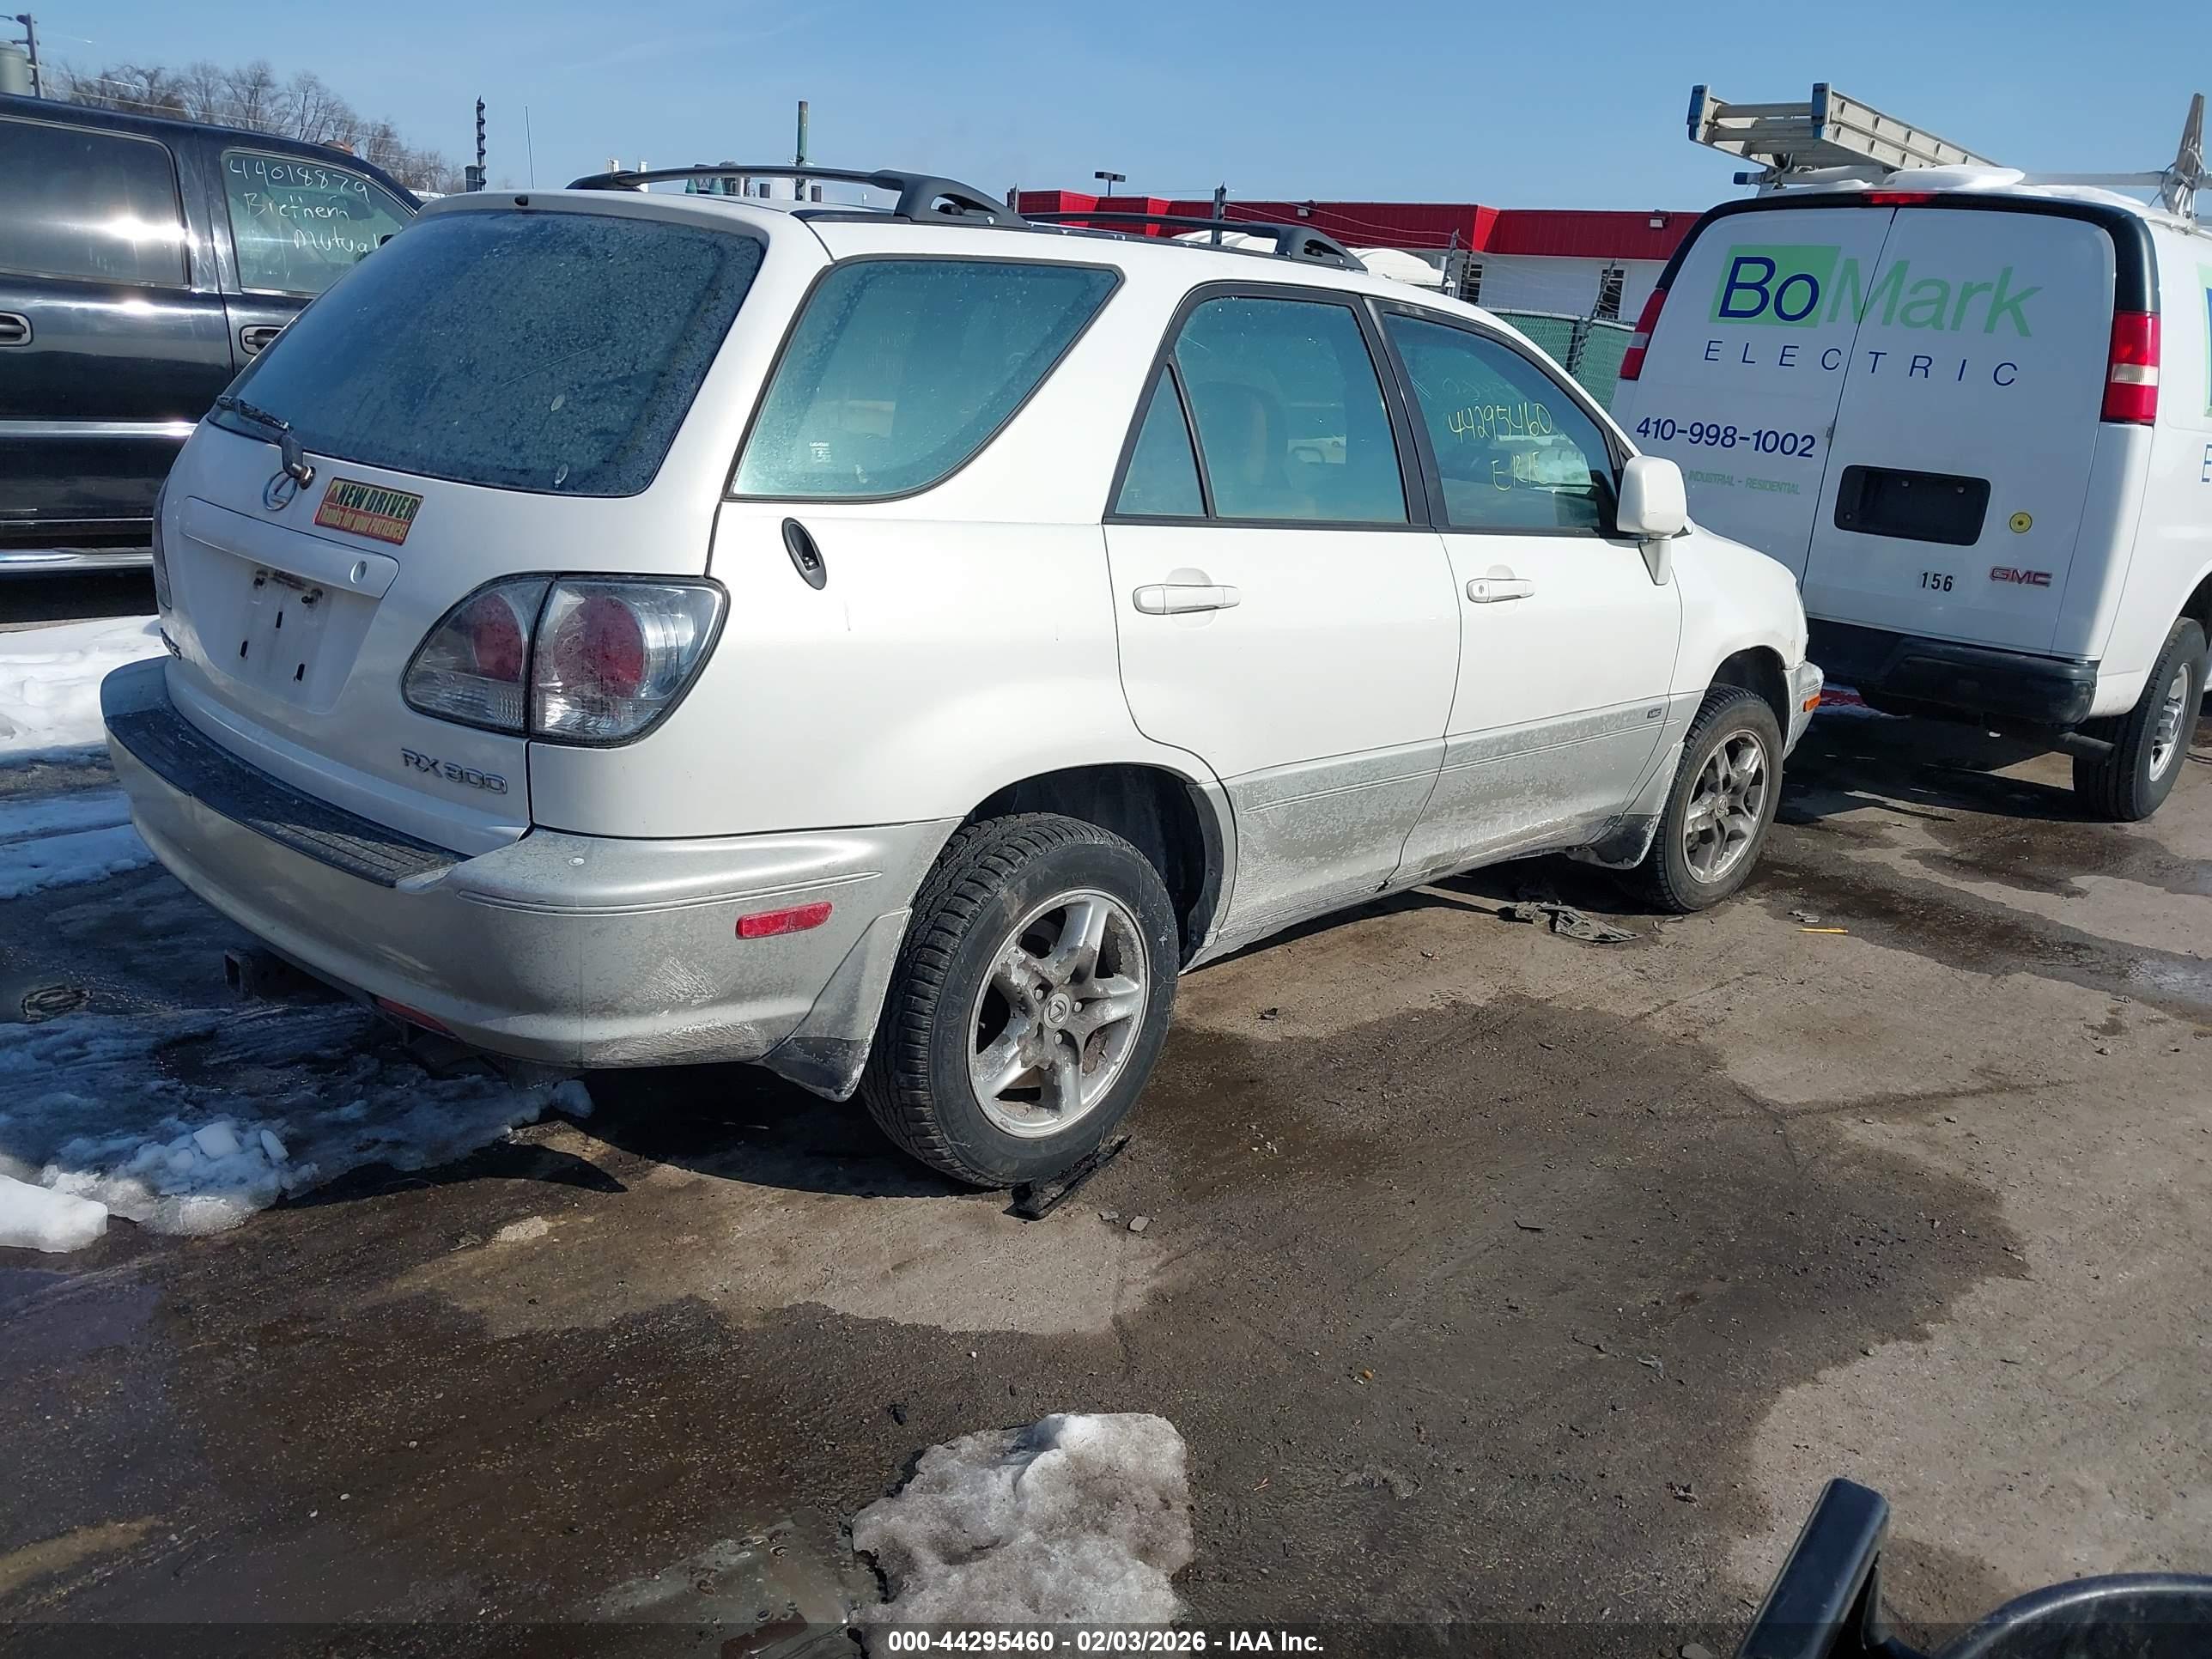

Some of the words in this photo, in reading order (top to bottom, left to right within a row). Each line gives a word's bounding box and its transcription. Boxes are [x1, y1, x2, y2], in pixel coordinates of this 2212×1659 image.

[293, 226, 380, 253] Mutual
[1717, 256, 2044, 338] BoMark
[1704, 339, 2019, 386] ELECTRIC
[1448, 402, 1553, 444] 44295460
[1636, 416, 1817, 459] 410-998-1002
[1491, 451, 1550, 491] ERIE
[1688, 469, 1735, 488] INDUSTRIAL
[1746, 477, 1801, 495] RESIDENTIAL
[336, 483, 370, 510] NEW
[363, 489, 420, 522] DRIVER
[1921, 571, 1954, 592] 156
[1989, 565, 2053, 588] GMC
